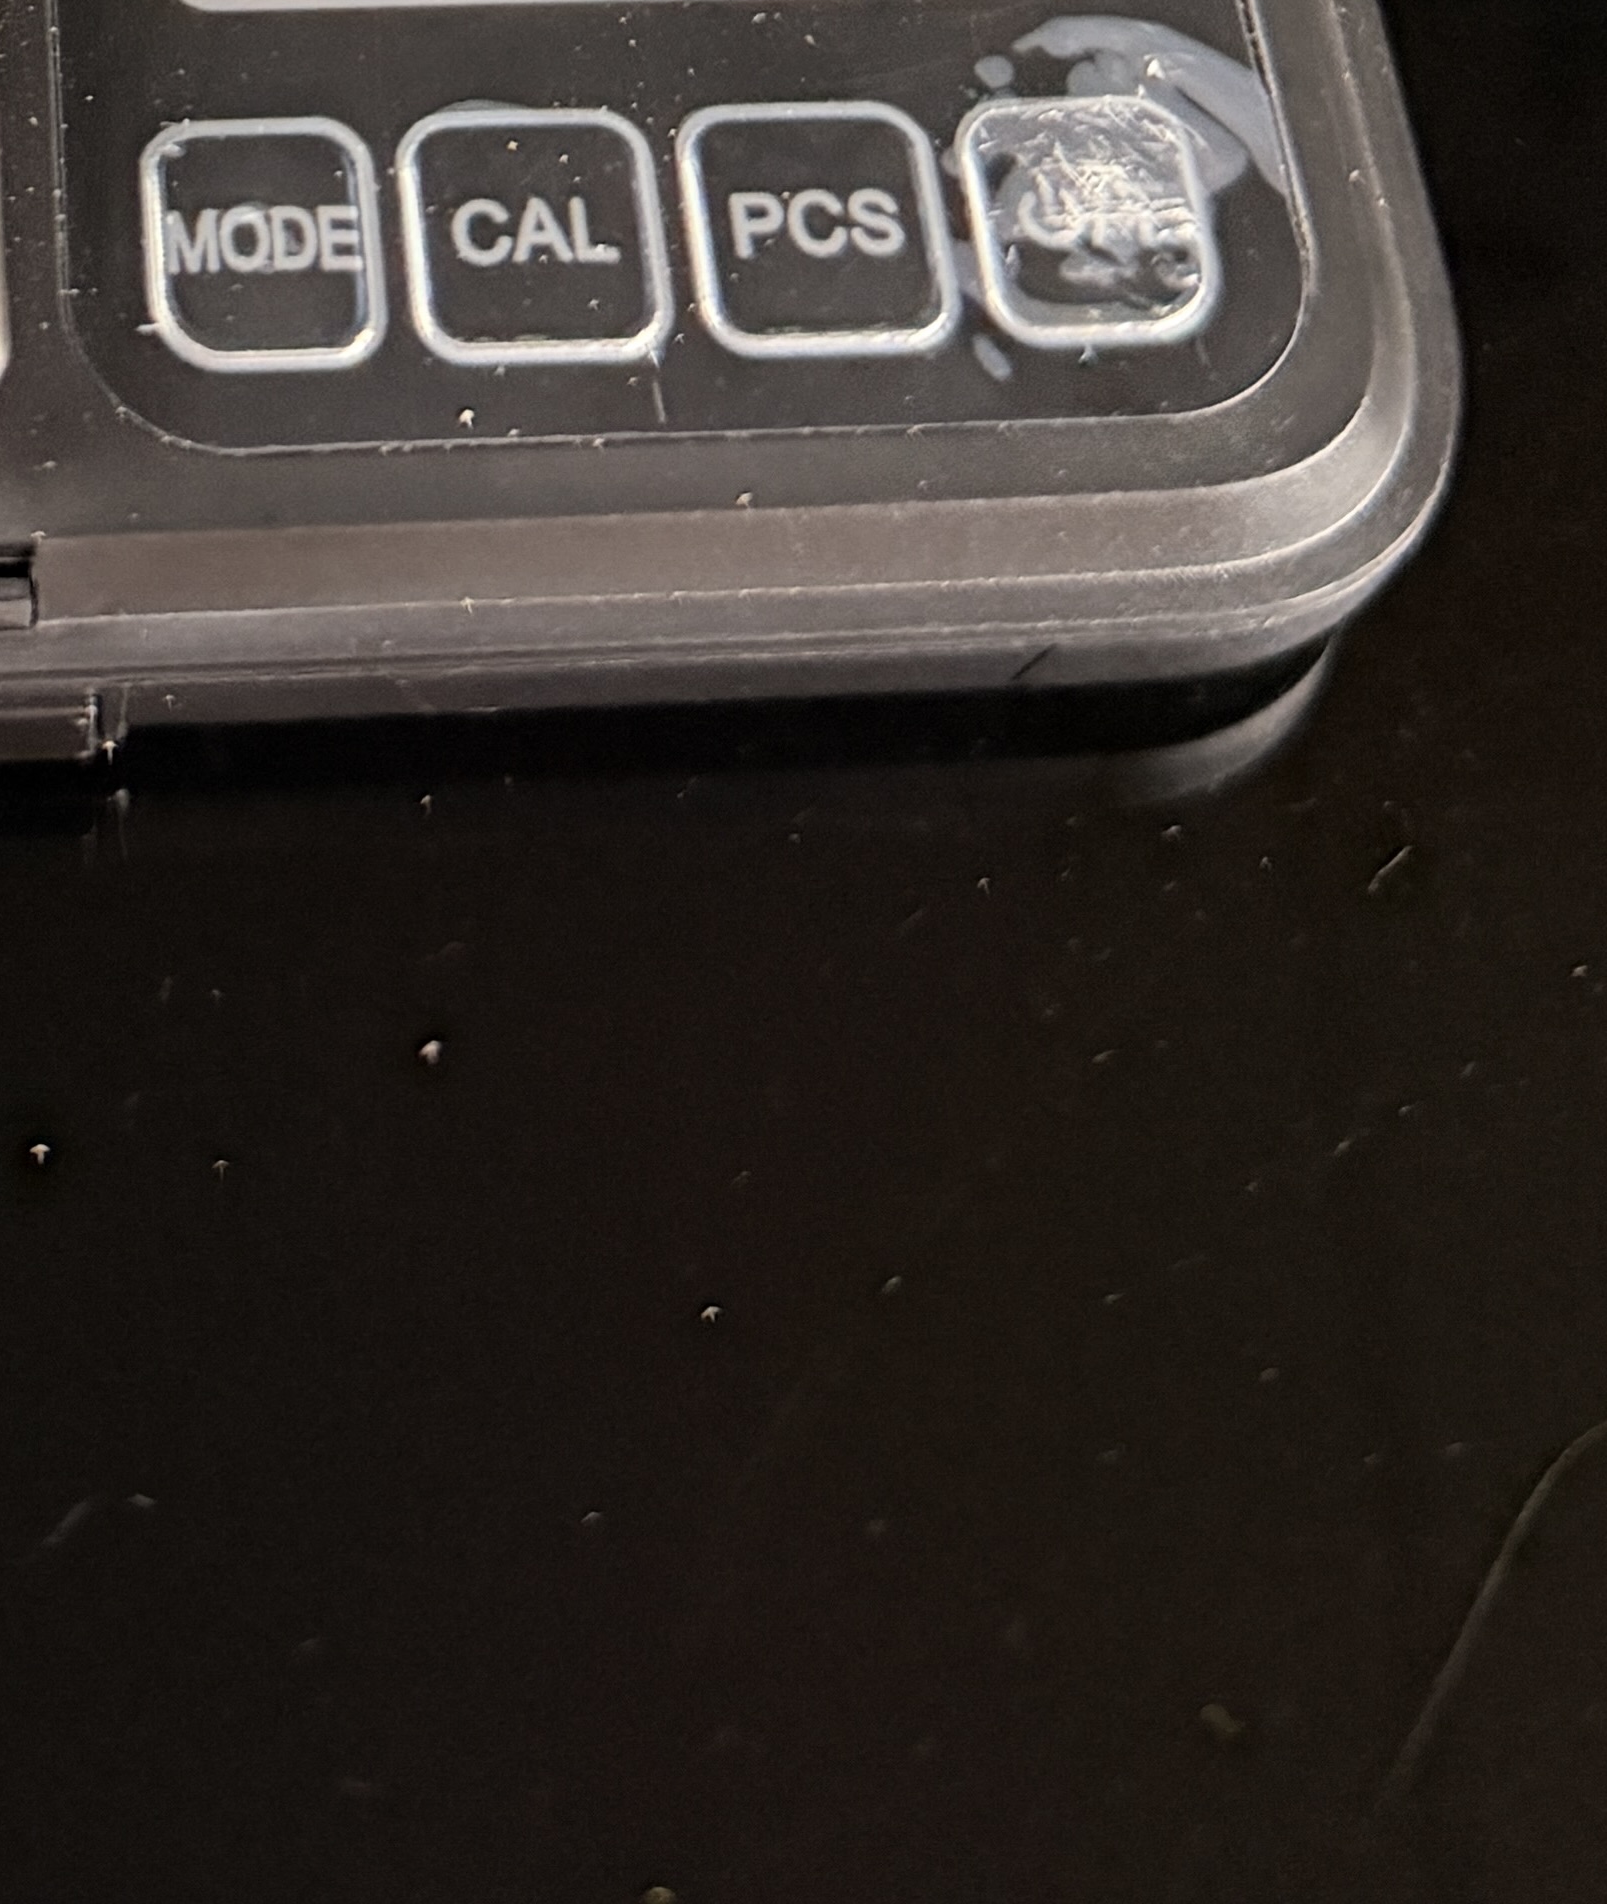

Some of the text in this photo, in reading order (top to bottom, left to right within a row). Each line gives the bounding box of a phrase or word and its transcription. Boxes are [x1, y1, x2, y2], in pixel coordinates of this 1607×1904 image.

[166, 204, 364, 274] MODE
[453, 197, 621, 268] CAL
[729, 189, 905, 258] PCS
